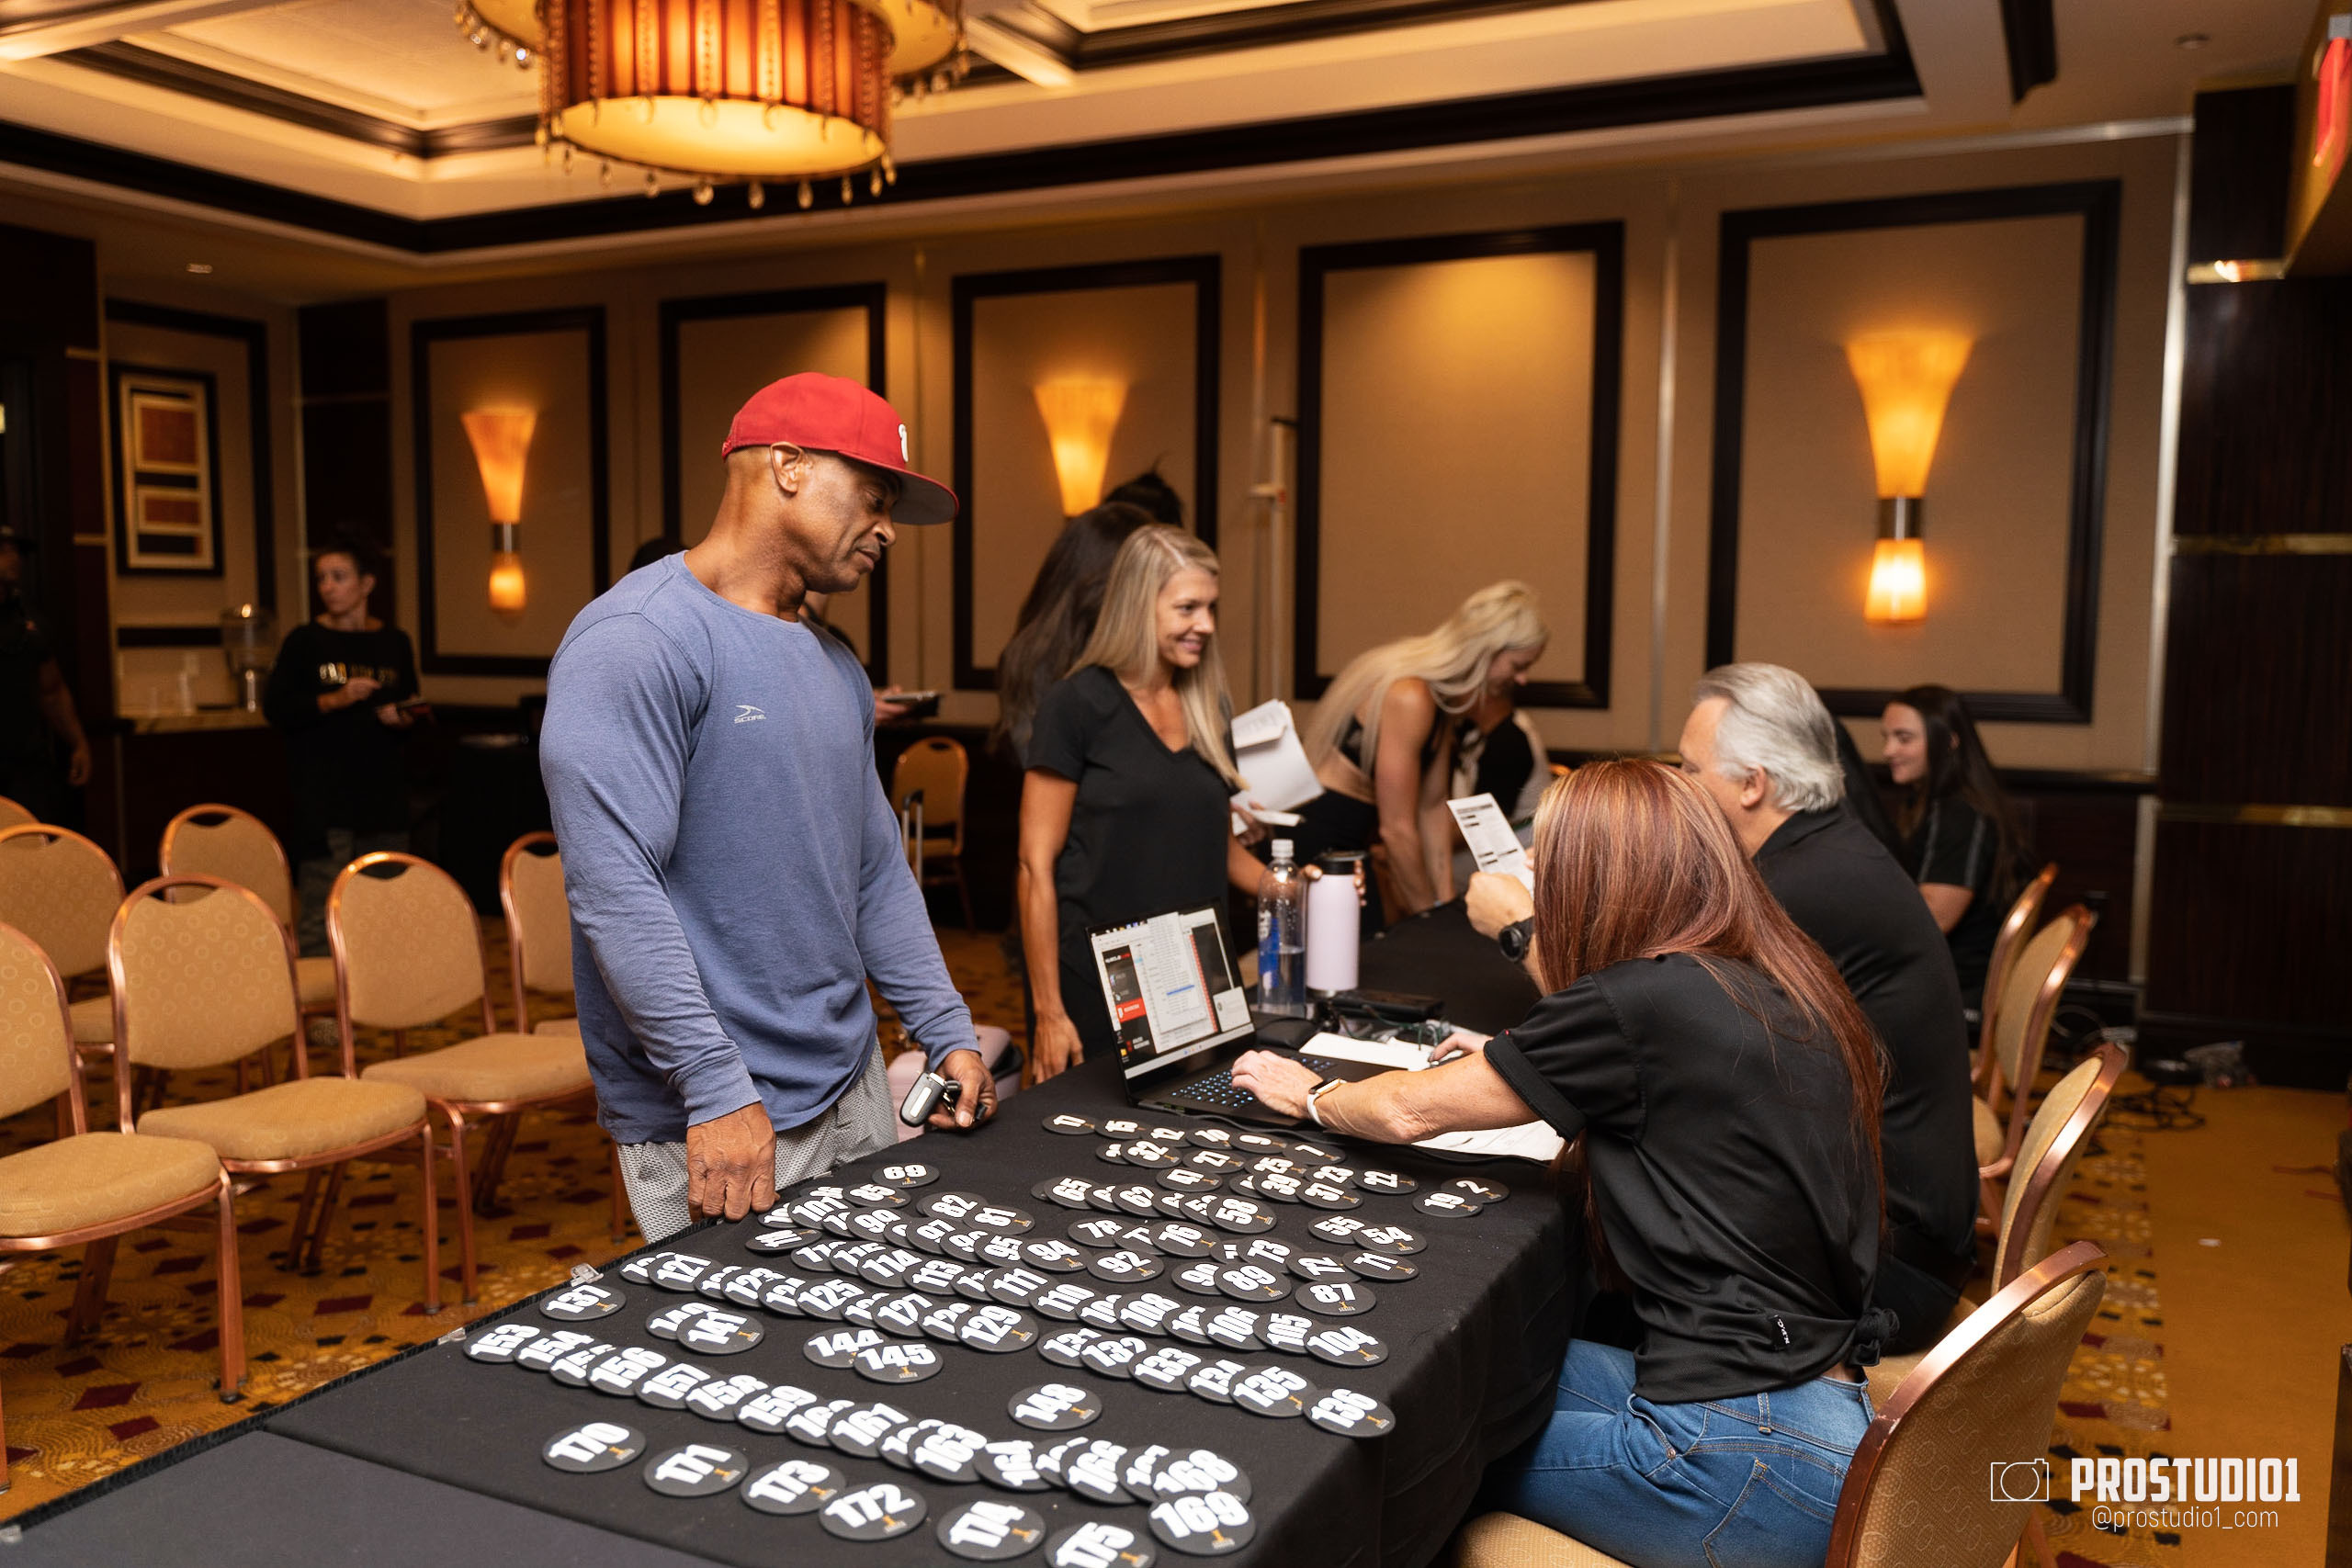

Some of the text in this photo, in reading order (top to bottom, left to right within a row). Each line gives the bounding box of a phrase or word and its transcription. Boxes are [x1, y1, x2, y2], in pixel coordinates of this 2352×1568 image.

[1105, 1120, 1138, 1134] 15
[1194, 1129, 1230, 1143] 10
[1238, 1134, 1272, 1146] 9
[1127, 1140, 1169, 1161] 32
[1253, 1156, 1294, 1174] 25
[883, 1164, 927, 1180] 69
[1261, 1173, 1301, 1196] 39
[1313, 1165, 1354, 1184] 23
[1363, 1170, 1398, 1188] 22
[850, 1184, 896, 1201] 85
[1052, 1178, 1092, 1201] 65
[1119, 1186, 1155, 1208] 62
[1423, 1192, 1465, 1210] 19
[1456, 1179, 1489, 1195] 2
[792, 1196, 848, 1223] 101
[931, 1195, 978, 1218] 82
[974, 1208, 1017, 1227] 81
[1215, 1198, 1258, 1224] 58
[916, 1219, 956, 1244] 97
[1077, 1220, 1123, 1239] 78
[1159, 1224, 1203, 1247] 76
[1314, 1216, 1365, 1235] 55
[1361, 1225, 1415, 1245] 54
[983, 1235, 1023, 1261] 95
[1026, 1240, 1080, 1262] 94
[1097, 1251, 1149, 1274] 92
[1246, 1239, 1291, 1264] 73
[657, 1254, 712, 1283] 121
[861, 1249, 923, 1278] 114
[911, 1260, 966, 1287] 113
[1297, 1256, 1346, 1277] 72
[725, 1267, 786, 1301] 123
[992, 1268, 1048, 1296] 111
[1222, 1265, 1276, 1292] 89
[1310, 1282, 1355, 1303] 87
[546, 1284, 612, 1314] 137
[797, 1279, 865, 1312] 125
[877, 1292, 933, 1327] 127
[1037, 1284, 1095, 1313] 110
[1120, 1292, 1182, 1328] 108
[688, 1311, 748, 1345] 141
[961, 1305, 1023, 1345] 129
[1206, 1306, 1260, 1343] 106
[1266, 1313, 1313, 1347] 105
[470, 1324, 540, 1357] 153
[518, 1330, 595, 1364] 154
[808, 1329, 884, 1358] 144
[1080, 1337, 1147, 1368] 132
[1306, 1325, 1379, 1357] 104
[590, 1347, 668, 1389] 156
[856, 1344, 937, 1371] 145
[1135, 1347, 1202, 1383] 133
[641, 1363, 710, 1400] 157
[1232, 1366, 1307, 1407] 135
[739, 1385, 818, 1426] 159
[1015, 1383, 1087, 1423] 148
[1310, 1388, 1378, 1428] 136
[832, 1403, 909, 1447] 161
[548, 1422, 630, 1462] 170
[915, 1423, 988, 1472] 163
[655, 1444, 732, 1484] 171
[1153, 1450, 1238, 1494] 168
[748, 1460, 831, 1504] 173
[824, 1483, 916, 1529] 172
[1150, 1491, 1250, 1539] 169
[950, 1501, 1025, 1549] 174
[1056, 1522, 1136, 1568] 175
